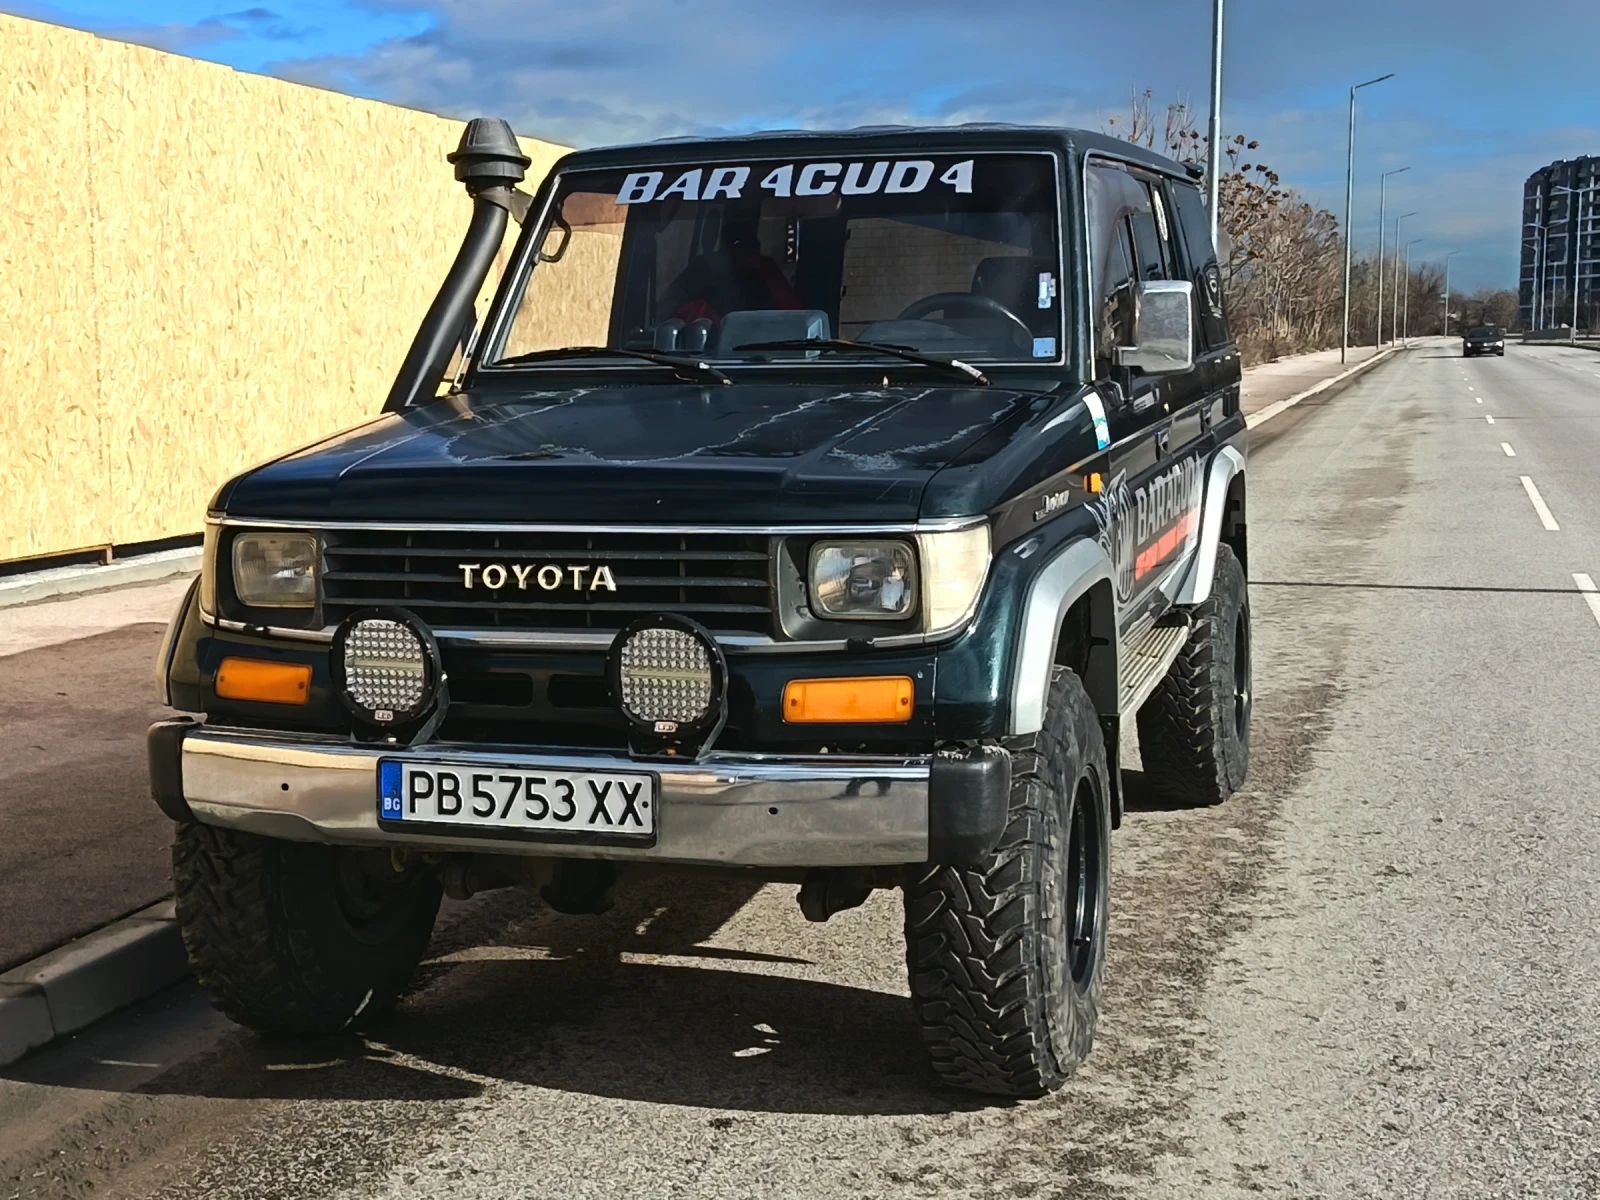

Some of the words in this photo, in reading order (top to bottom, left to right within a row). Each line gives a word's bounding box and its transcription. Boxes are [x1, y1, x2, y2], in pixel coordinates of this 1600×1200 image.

[458, 563, 617, 591] TOYOTA
[384, 797, 400, 810] BG
[409, 770, 463, 815] PB
[472, 774, 576, 822] 5753
[588, 779, 643, 826] XX
